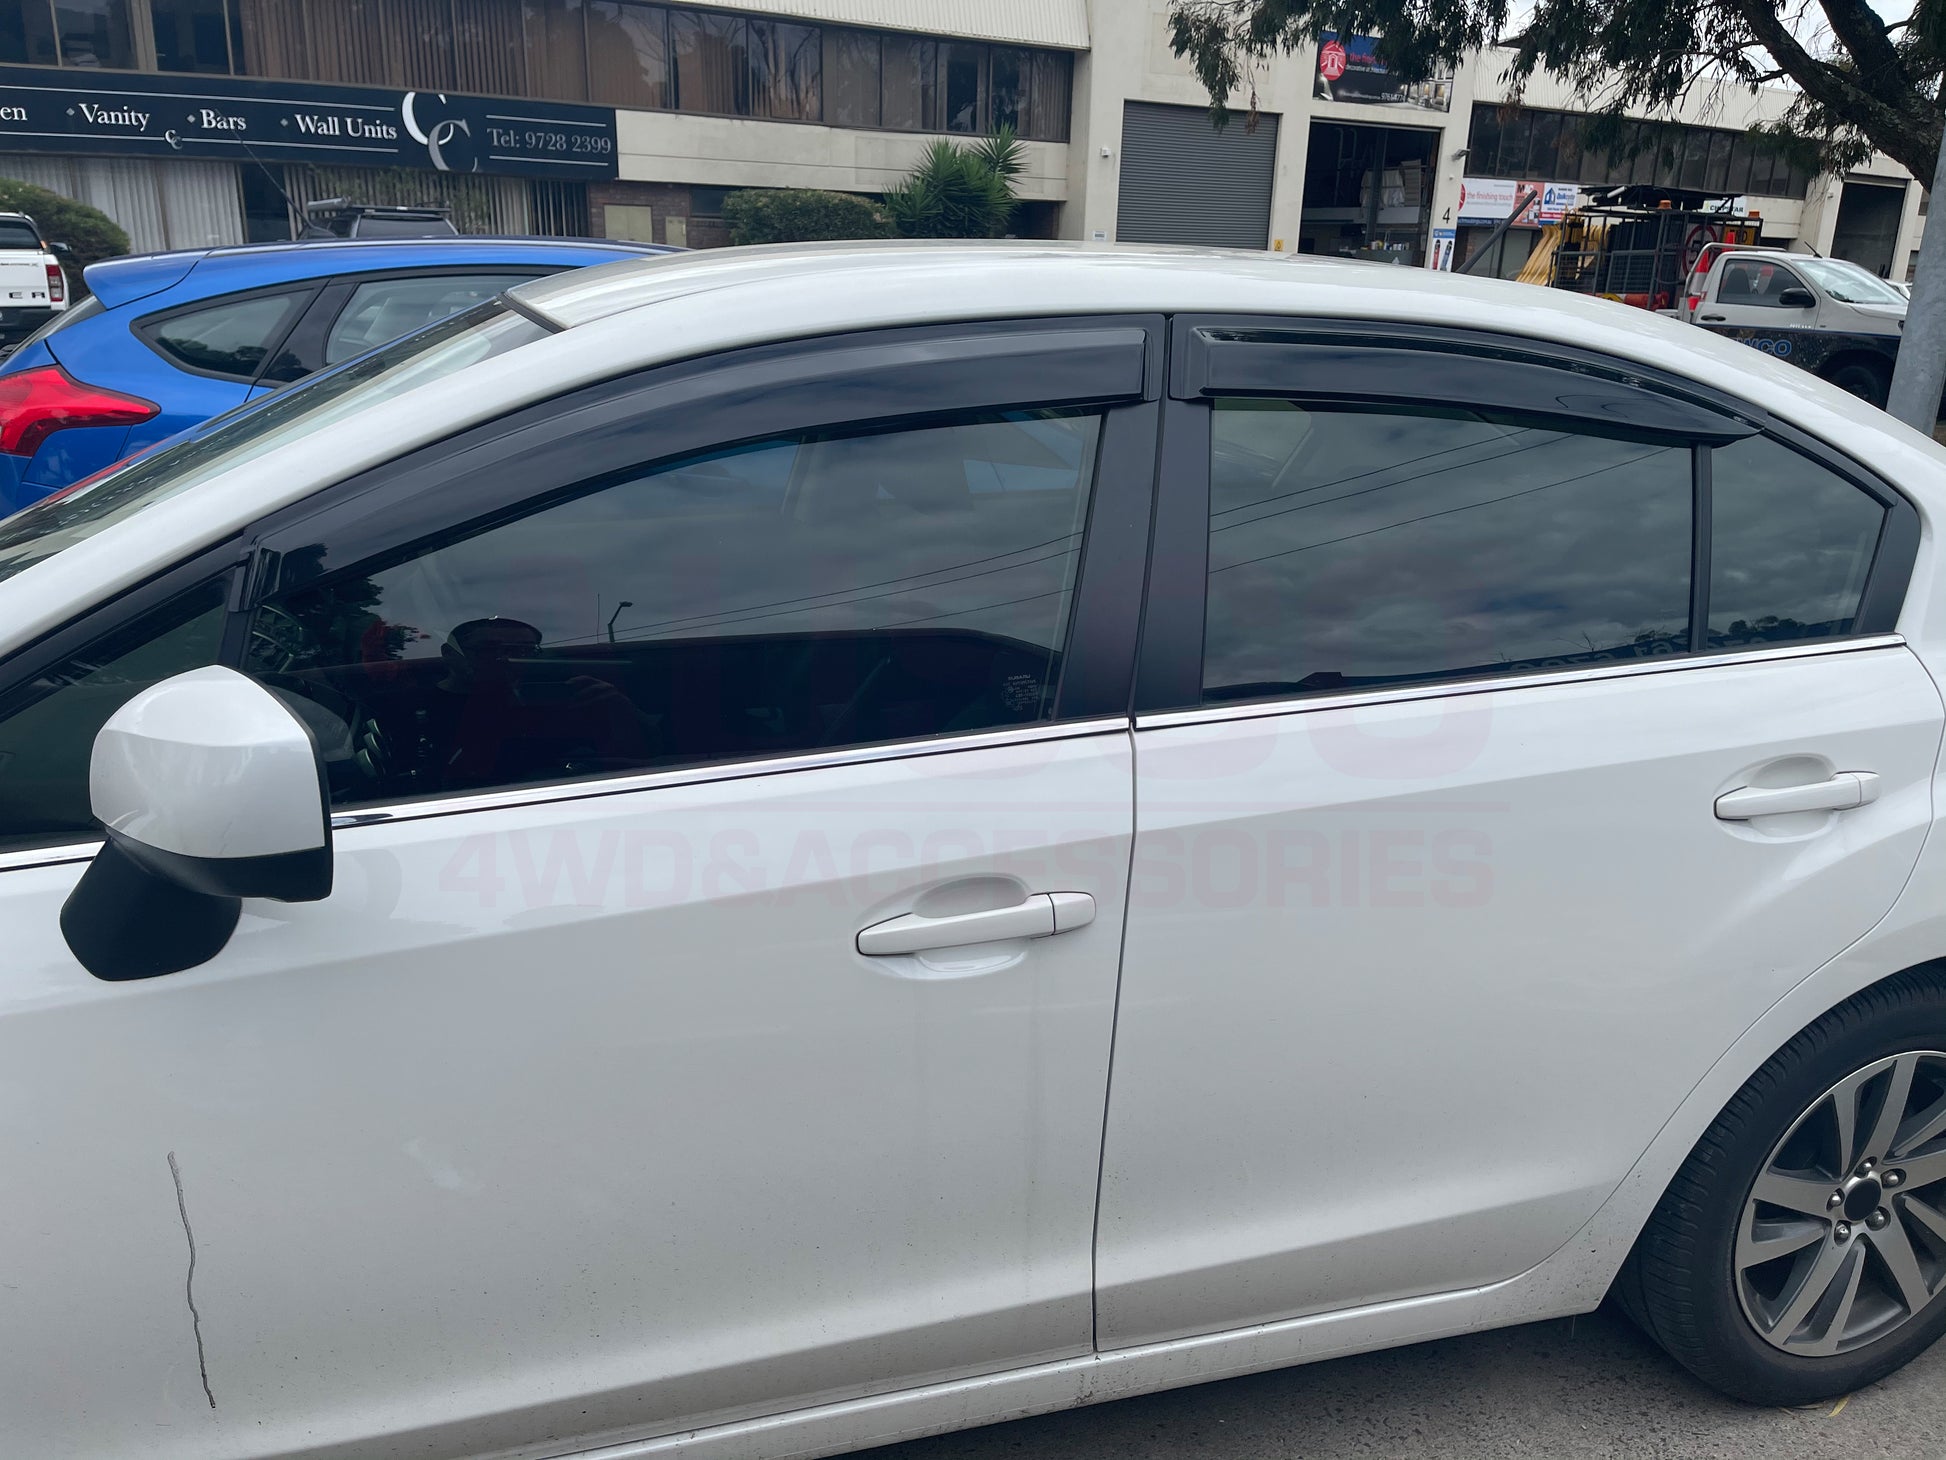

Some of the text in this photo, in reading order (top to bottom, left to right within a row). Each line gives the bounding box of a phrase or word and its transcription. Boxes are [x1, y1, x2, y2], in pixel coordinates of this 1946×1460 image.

[79, 103, 150, 131] Vanity
[200, 109, 246, 130] Bars
[294, 114, 340, 135] Wall
[345, 117, 397, 139] Units
[487, 128, 611, 153] Tel: 9728 2399
[1442, 207, 1451, 224] 4
